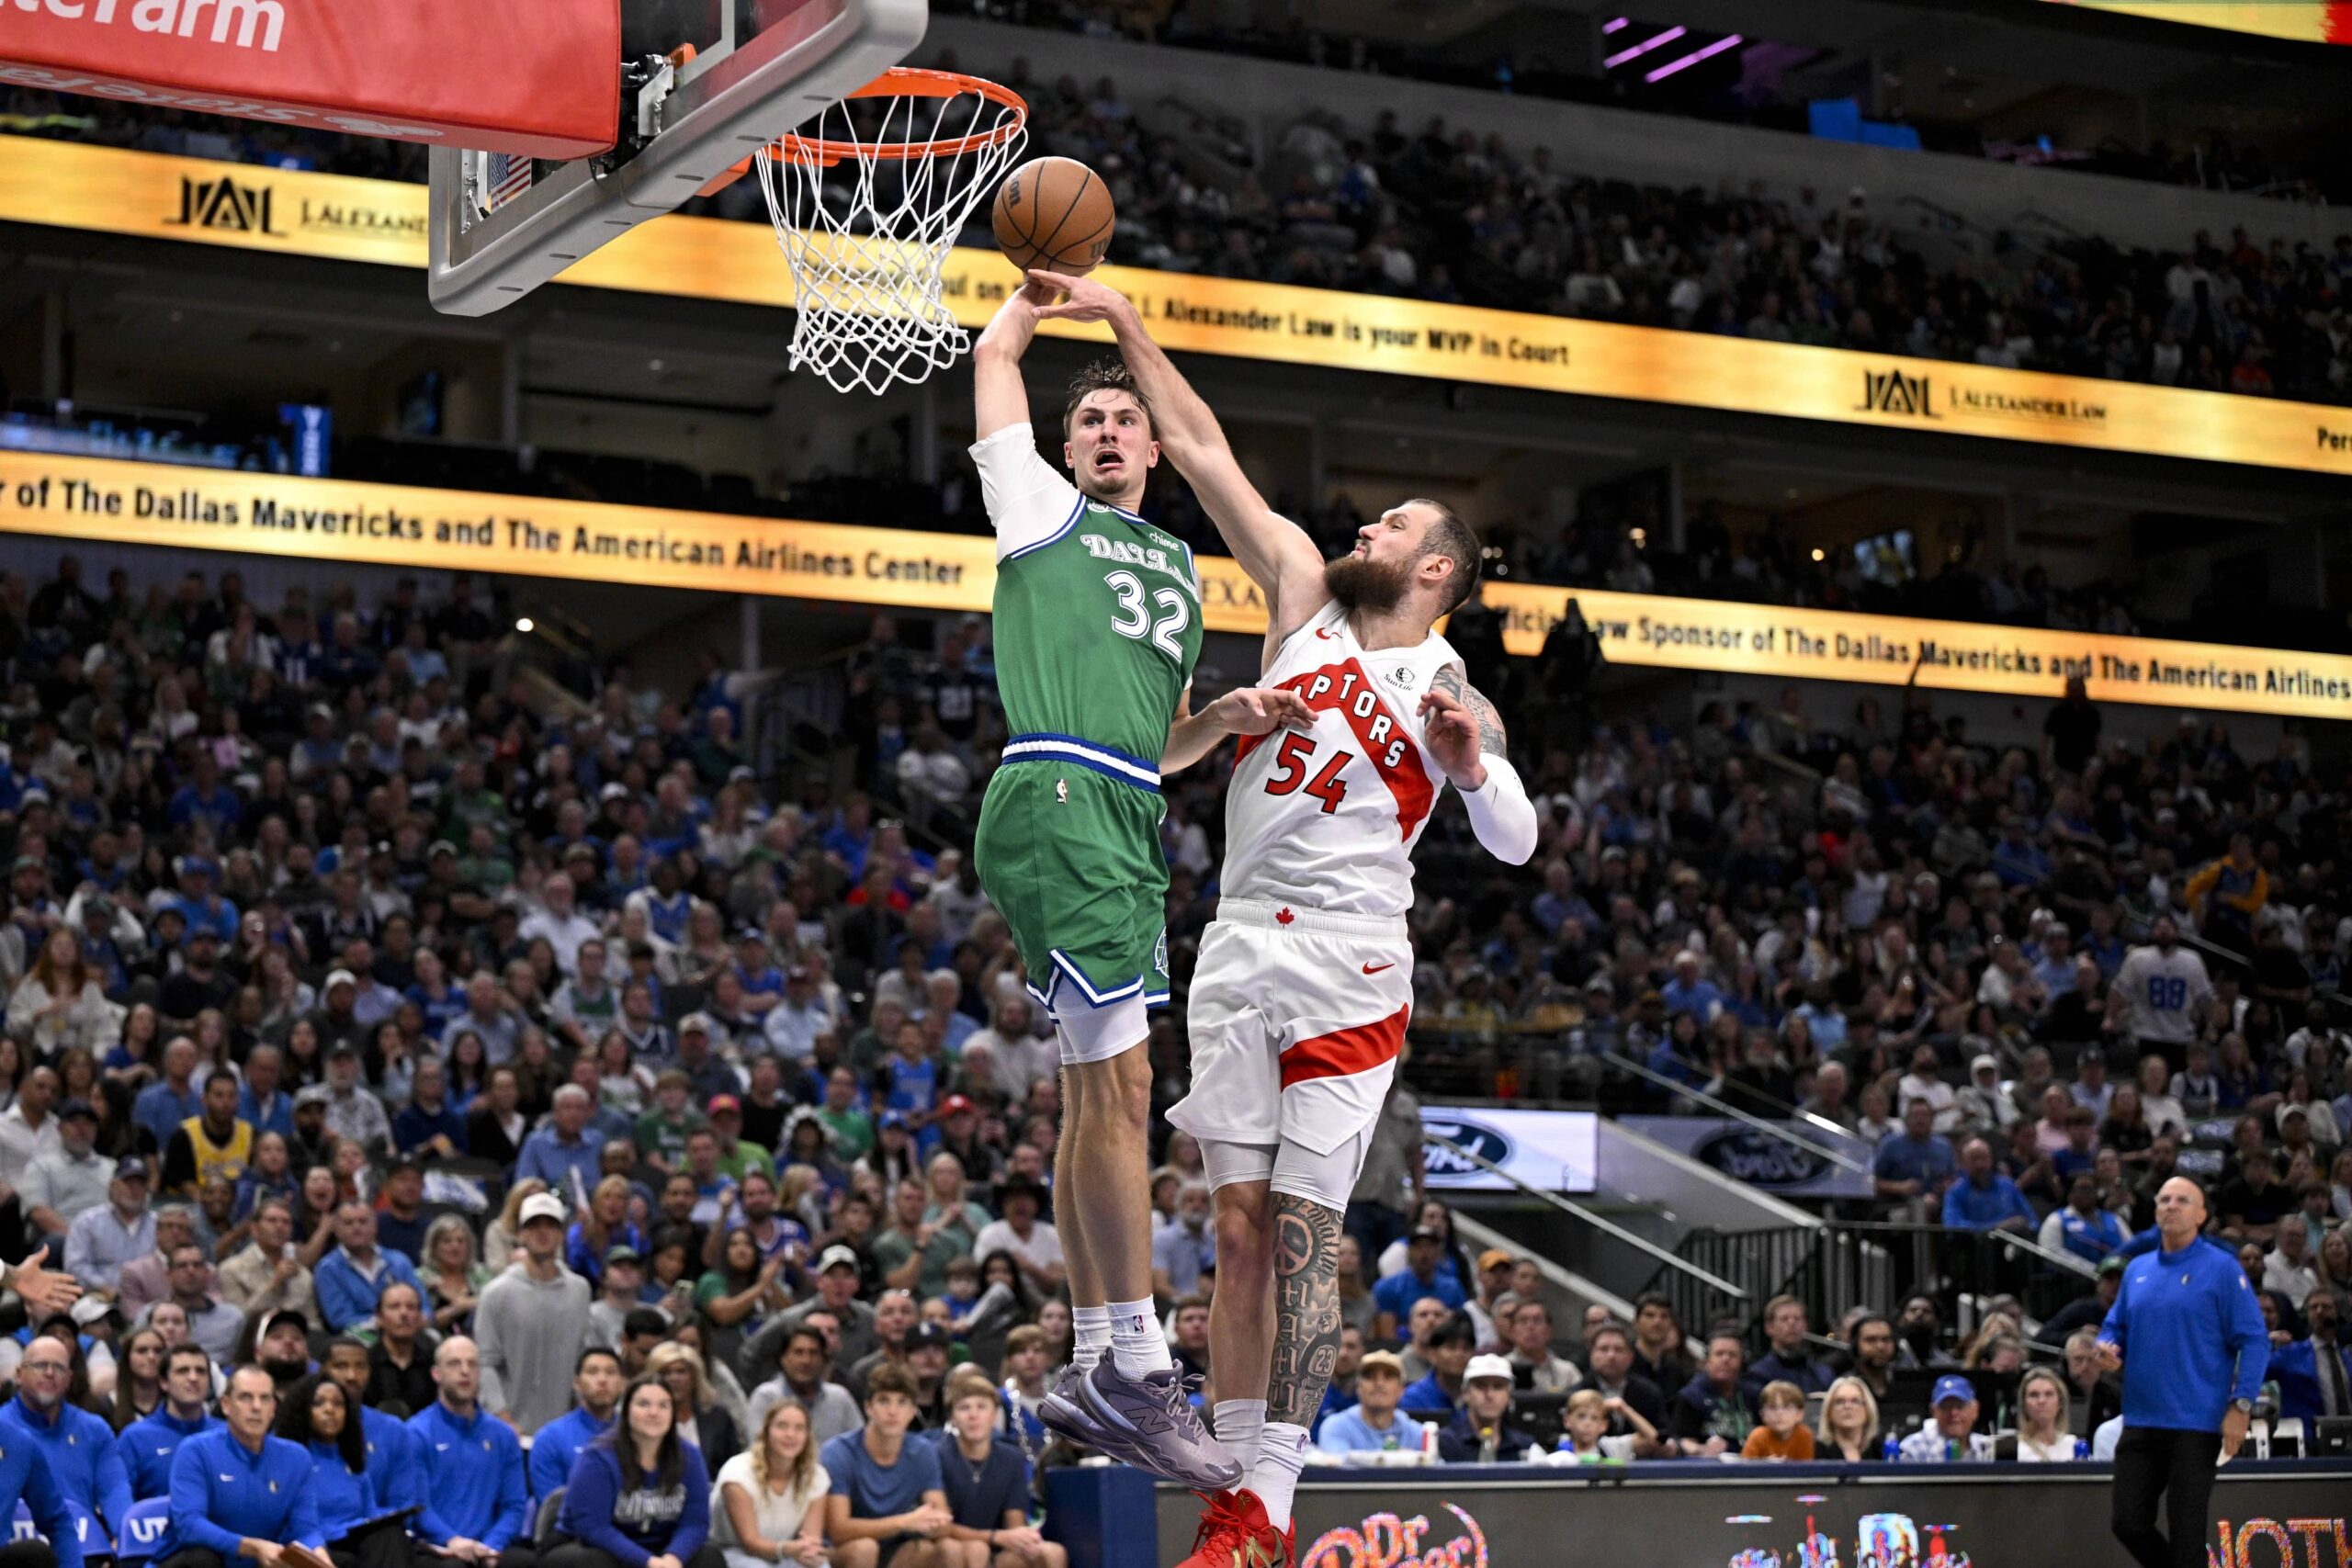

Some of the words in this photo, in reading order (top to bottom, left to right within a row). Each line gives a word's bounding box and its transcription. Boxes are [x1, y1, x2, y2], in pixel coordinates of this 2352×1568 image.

[1164, 299, 1282, 332] Alexander
[1291, 313, 1335, 338] Law
[1344, 323, 1362, 342] is
[1371, 328, 1419, 351] your
[1428, 329, 1474, 353] MVP
[1480, 335, 1501, 357] in
[1509, 338, 1568, 366] Court
[2317, 426, 2352, 451] Per
[17, 476, 51, 509] of
[61, 479, 121, 515] The
[134, 487, 239, 525] Dallas
[252, 497, 424, 542] Mavericks
[435, 516, 493, 547] and
[506, 518, 561, 552] The
[572, 525, 725, 567] American
[735, 539, 854, 578] Airlines
[865, 551, 964, 584] Center
[1149, 532, 1181, 552] chime
[1103, 570, 1189, 663] 32
[1638, 616, 1742, 653] Sponsor
[1753, 627, 1775, 651] of
[1785, 628, 1826, 657] The
[1836, 634, 1910, 663] Dallas
[1918, 639, 2041, 677] Mavericks
[2049, 653, 2093, 678] and
[2099, 653, 2142, 682] The
[2148, 658, 2257, 692] American
[2266, 668, 2351, 700] Airlines
[1263, 730, 1354, 816] 54
